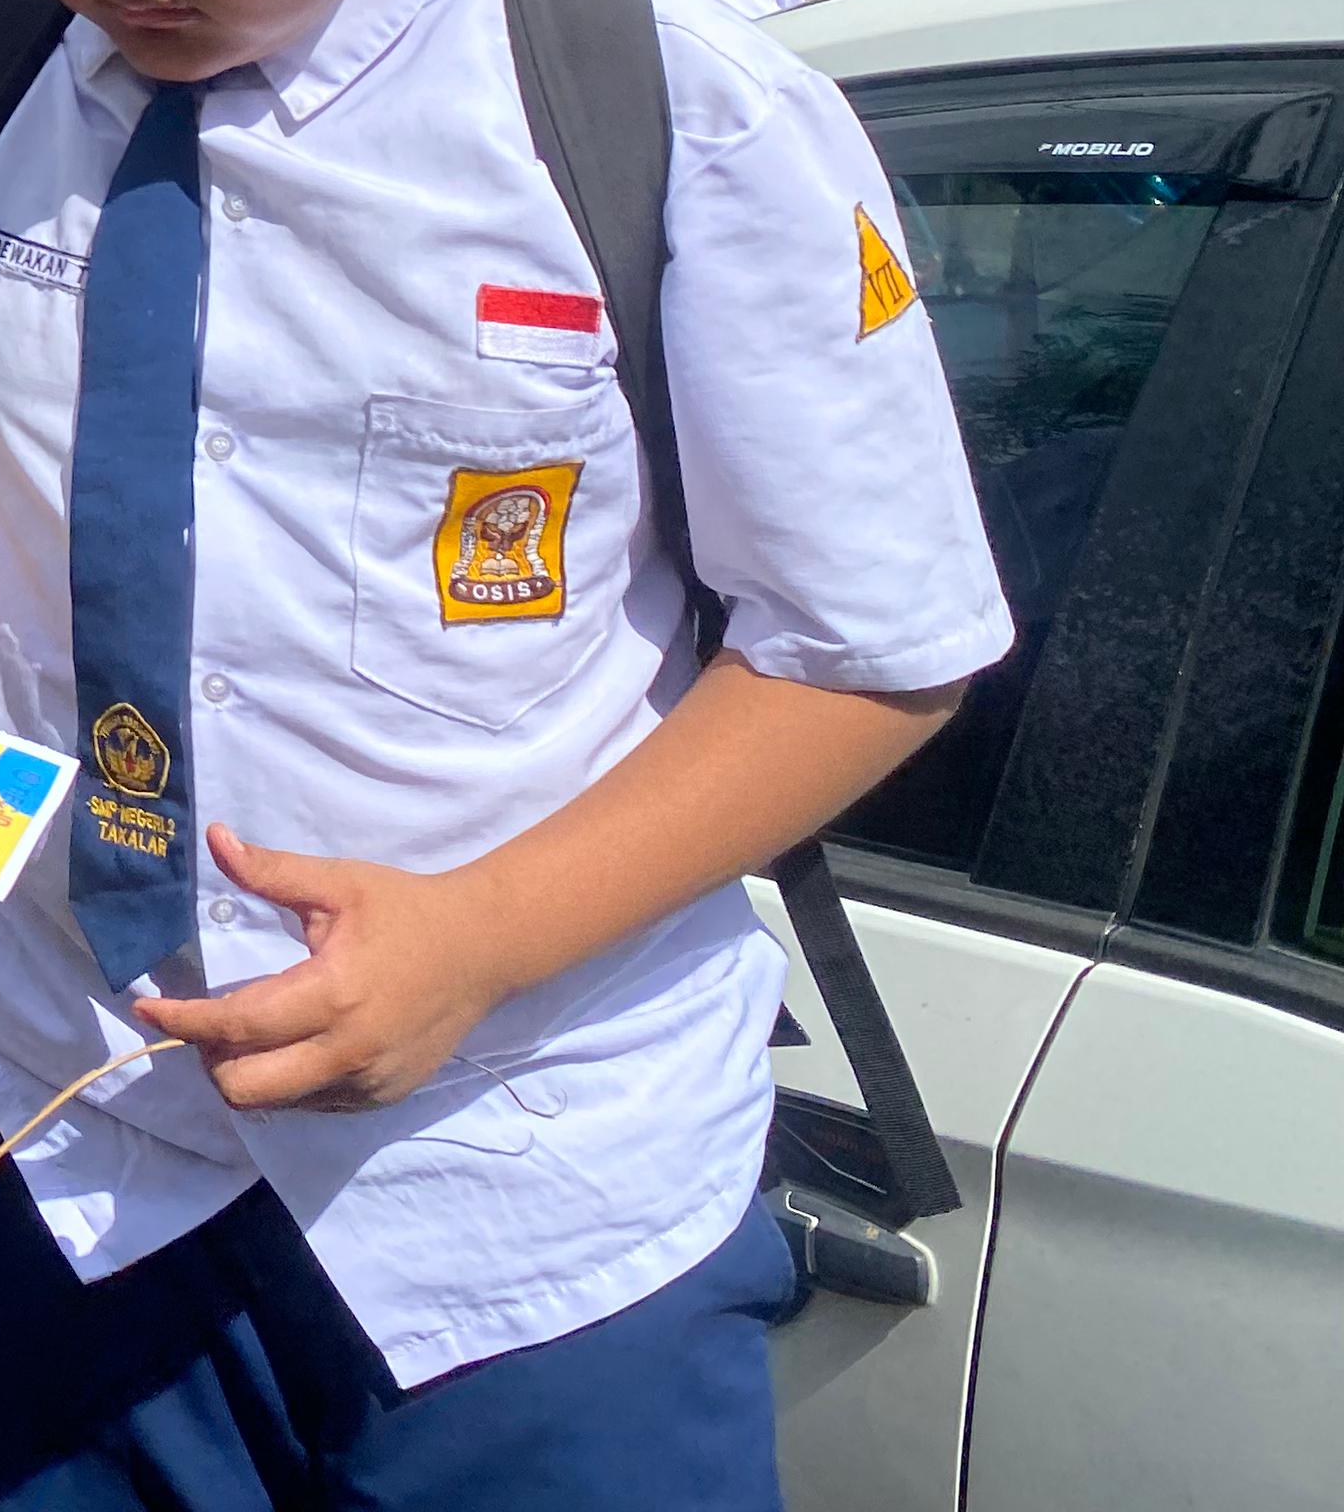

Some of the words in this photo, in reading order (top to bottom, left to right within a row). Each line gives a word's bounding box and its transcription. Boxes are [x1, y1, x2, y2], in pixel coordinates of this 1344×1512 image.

[1051, 142, 1156, 157] MOBILIO
[472, 581, 532, 601] OSIS
[86, 795, 117, 819] SMP
[98, 820, 168, 858] TAKALAR
